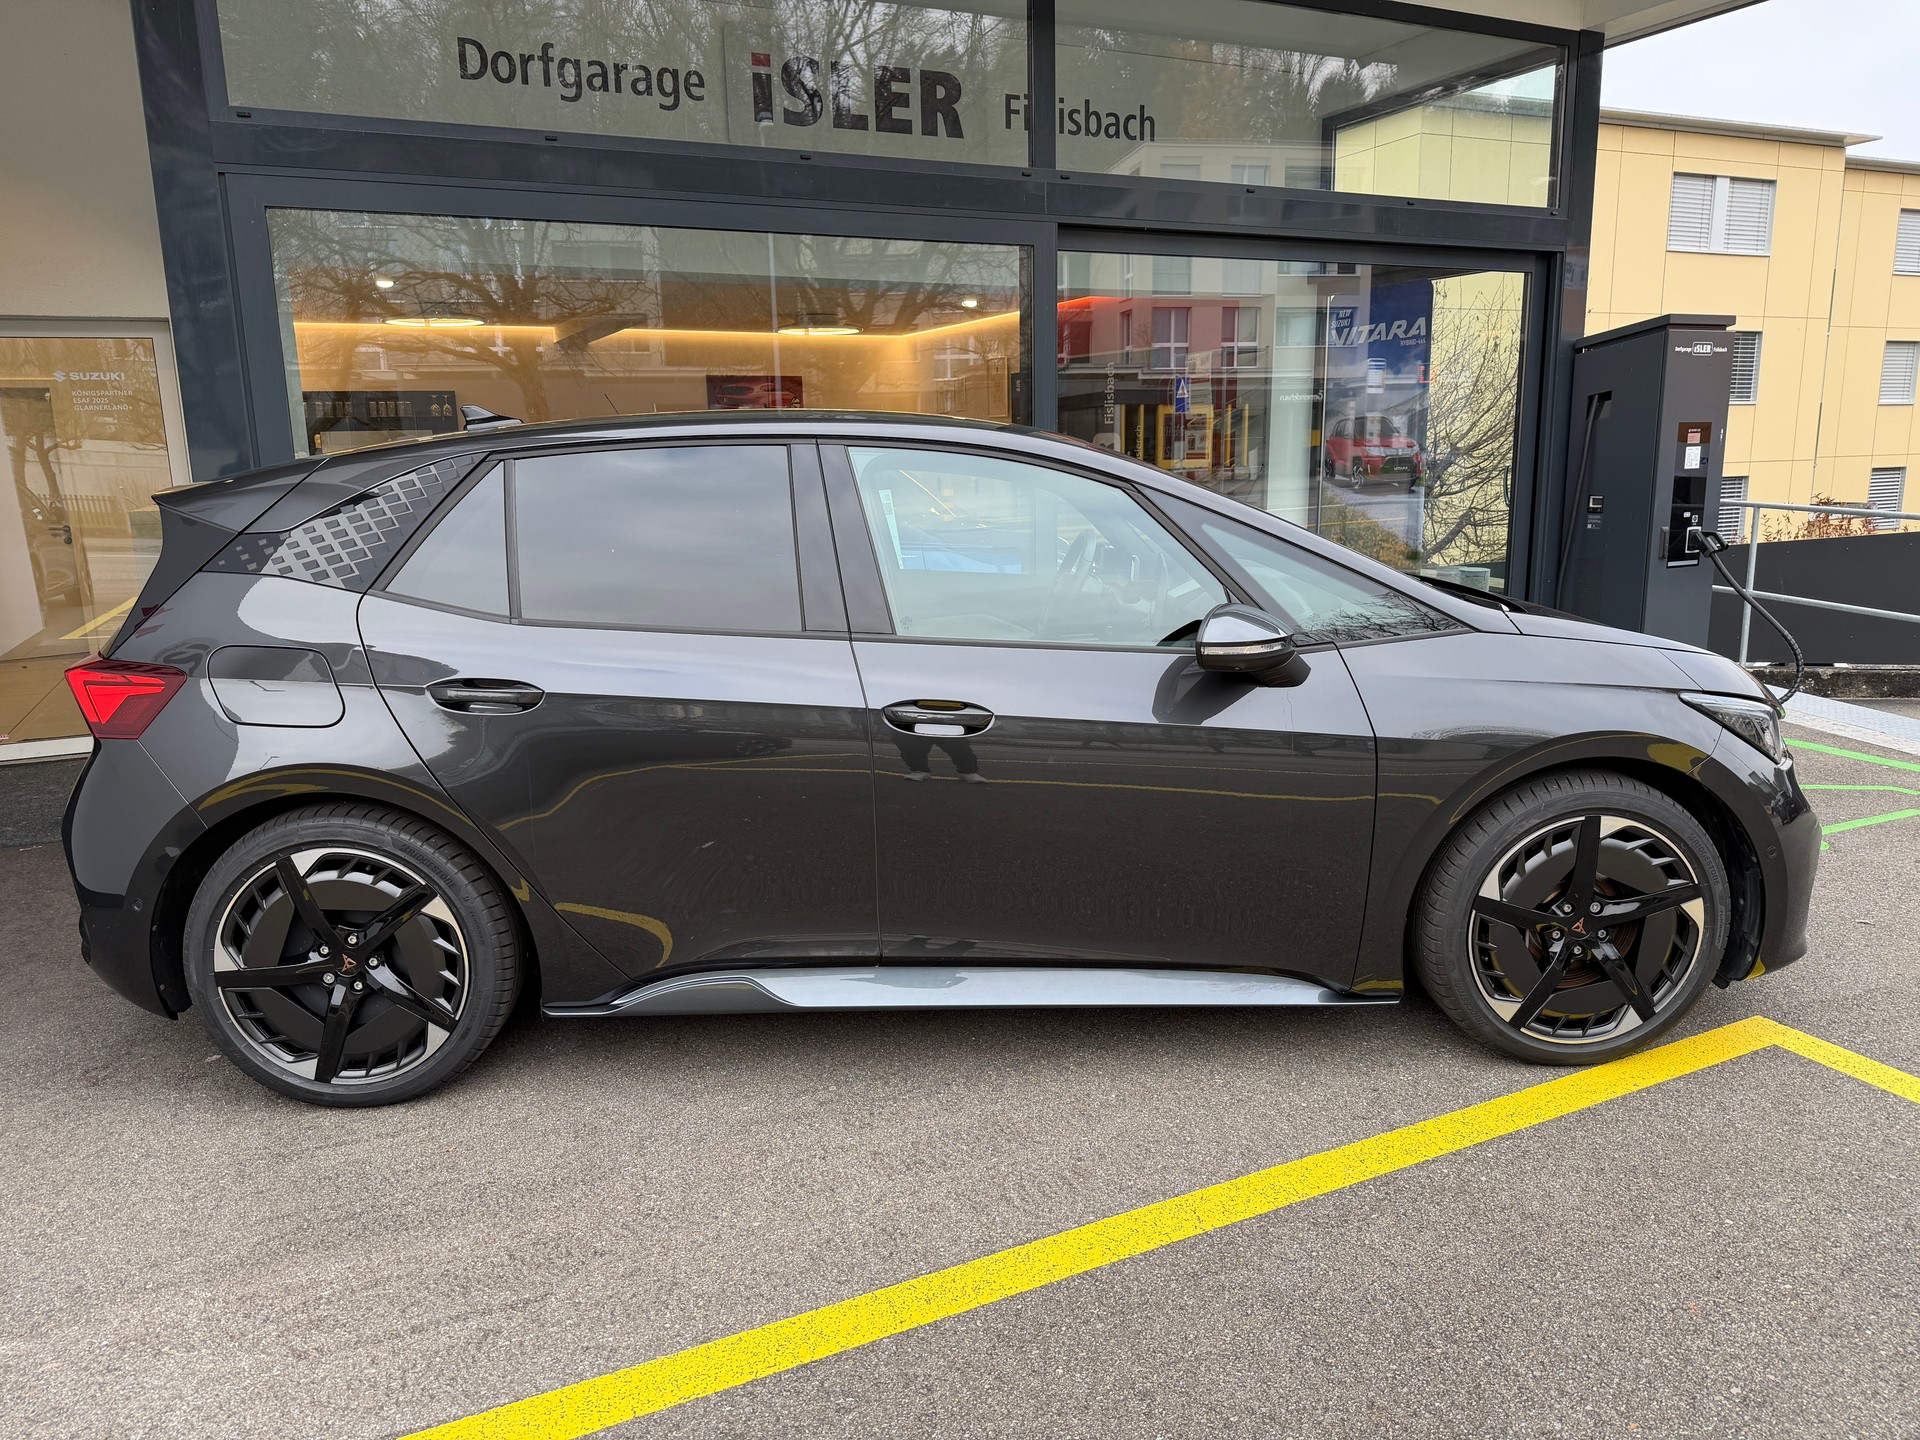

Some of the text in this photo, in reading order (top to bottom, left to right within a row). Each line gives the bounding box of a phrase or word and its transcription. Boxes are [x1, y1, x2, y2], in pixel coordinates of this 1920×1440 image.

[456, 36, 1156, 142] Dorfgarage iSLER Fiisbach
[1338, 309, 1353, 318] NEW
[1330, 319, 1351, 329] SUZUKI
[1330, 316, 1427, 346] VITARA
[69, 372, 125, 380] SUZUKI
[1104, 361, 1115, 425] Fislisbach
